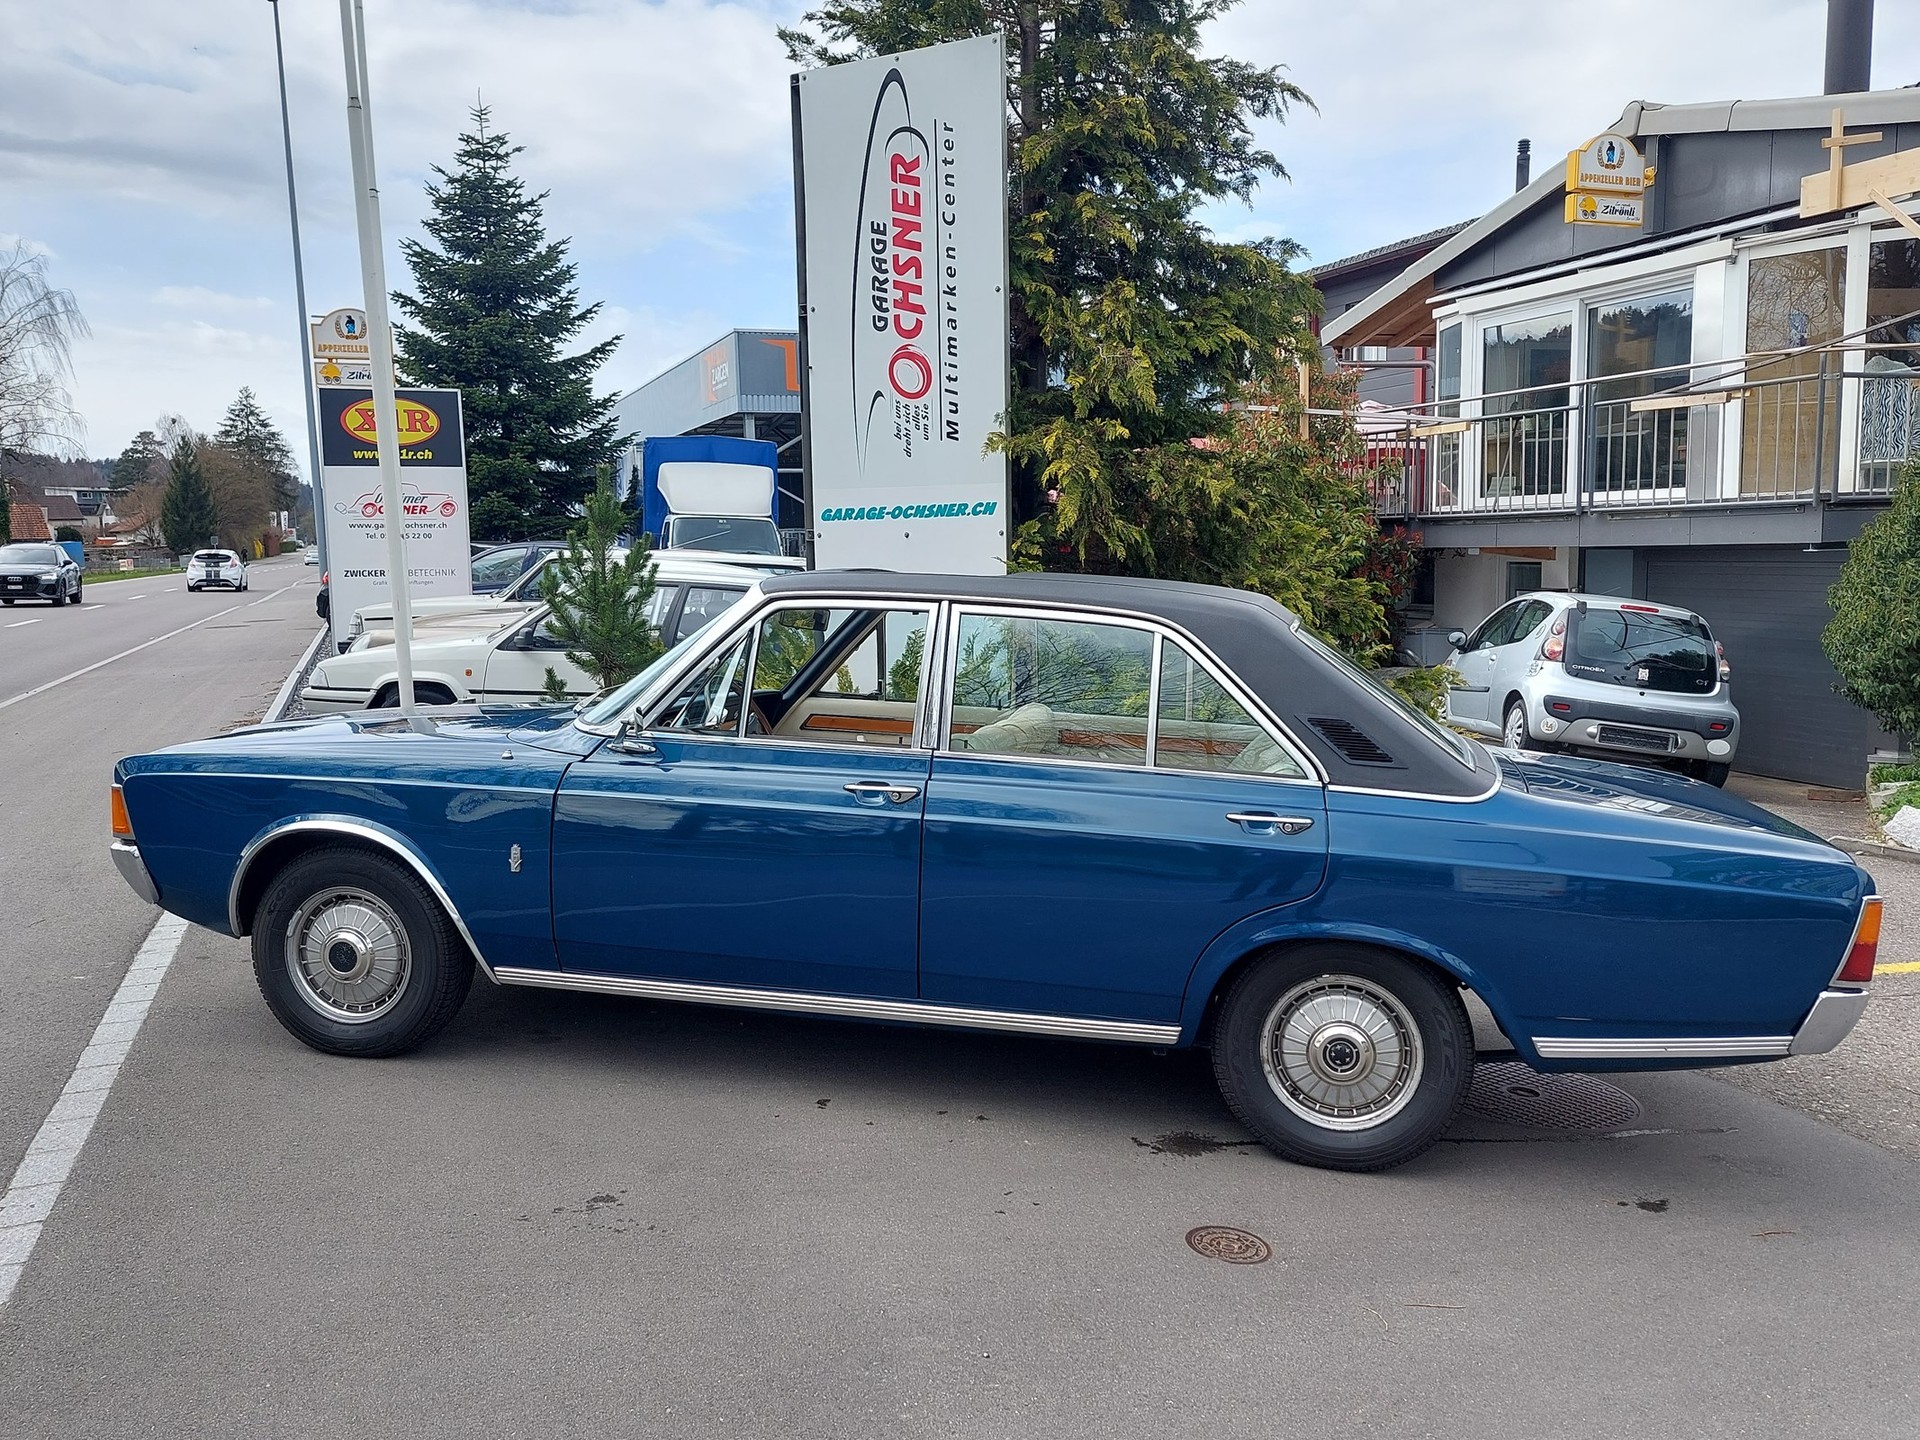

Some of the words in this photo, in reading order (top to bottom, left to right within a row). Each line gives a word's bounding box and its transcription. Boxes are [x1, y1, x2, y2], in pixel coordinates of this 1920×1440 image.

[1580, 173, 1623, 186] APPENZELLER
[1625, 176, 1641, 187] BIER
[871, 220, 890, 332] GARAGE
[888, 152, 933, 400] OCHSNER
[942, 121, 960, 441] Multimarken-Center
[902, 403, 911, 426] sich
[911, 404, 920, 431] alles
[921, 403, 930, 422] Sie
[893, 420, 902, 441] bei
[922, 423, 930, 441] um
[902, 427, 912, 458] dreht
[353, 449, 433, 460] www1r.ch
[820, 502, 998, 521] GARAGE-OCHSNER.CH
[348, 522, 448, 530] www.gaochsner.ch
[343, 569, 386, 577] ZWICKER
[388, 568, 457, 577] BETECHNIK
